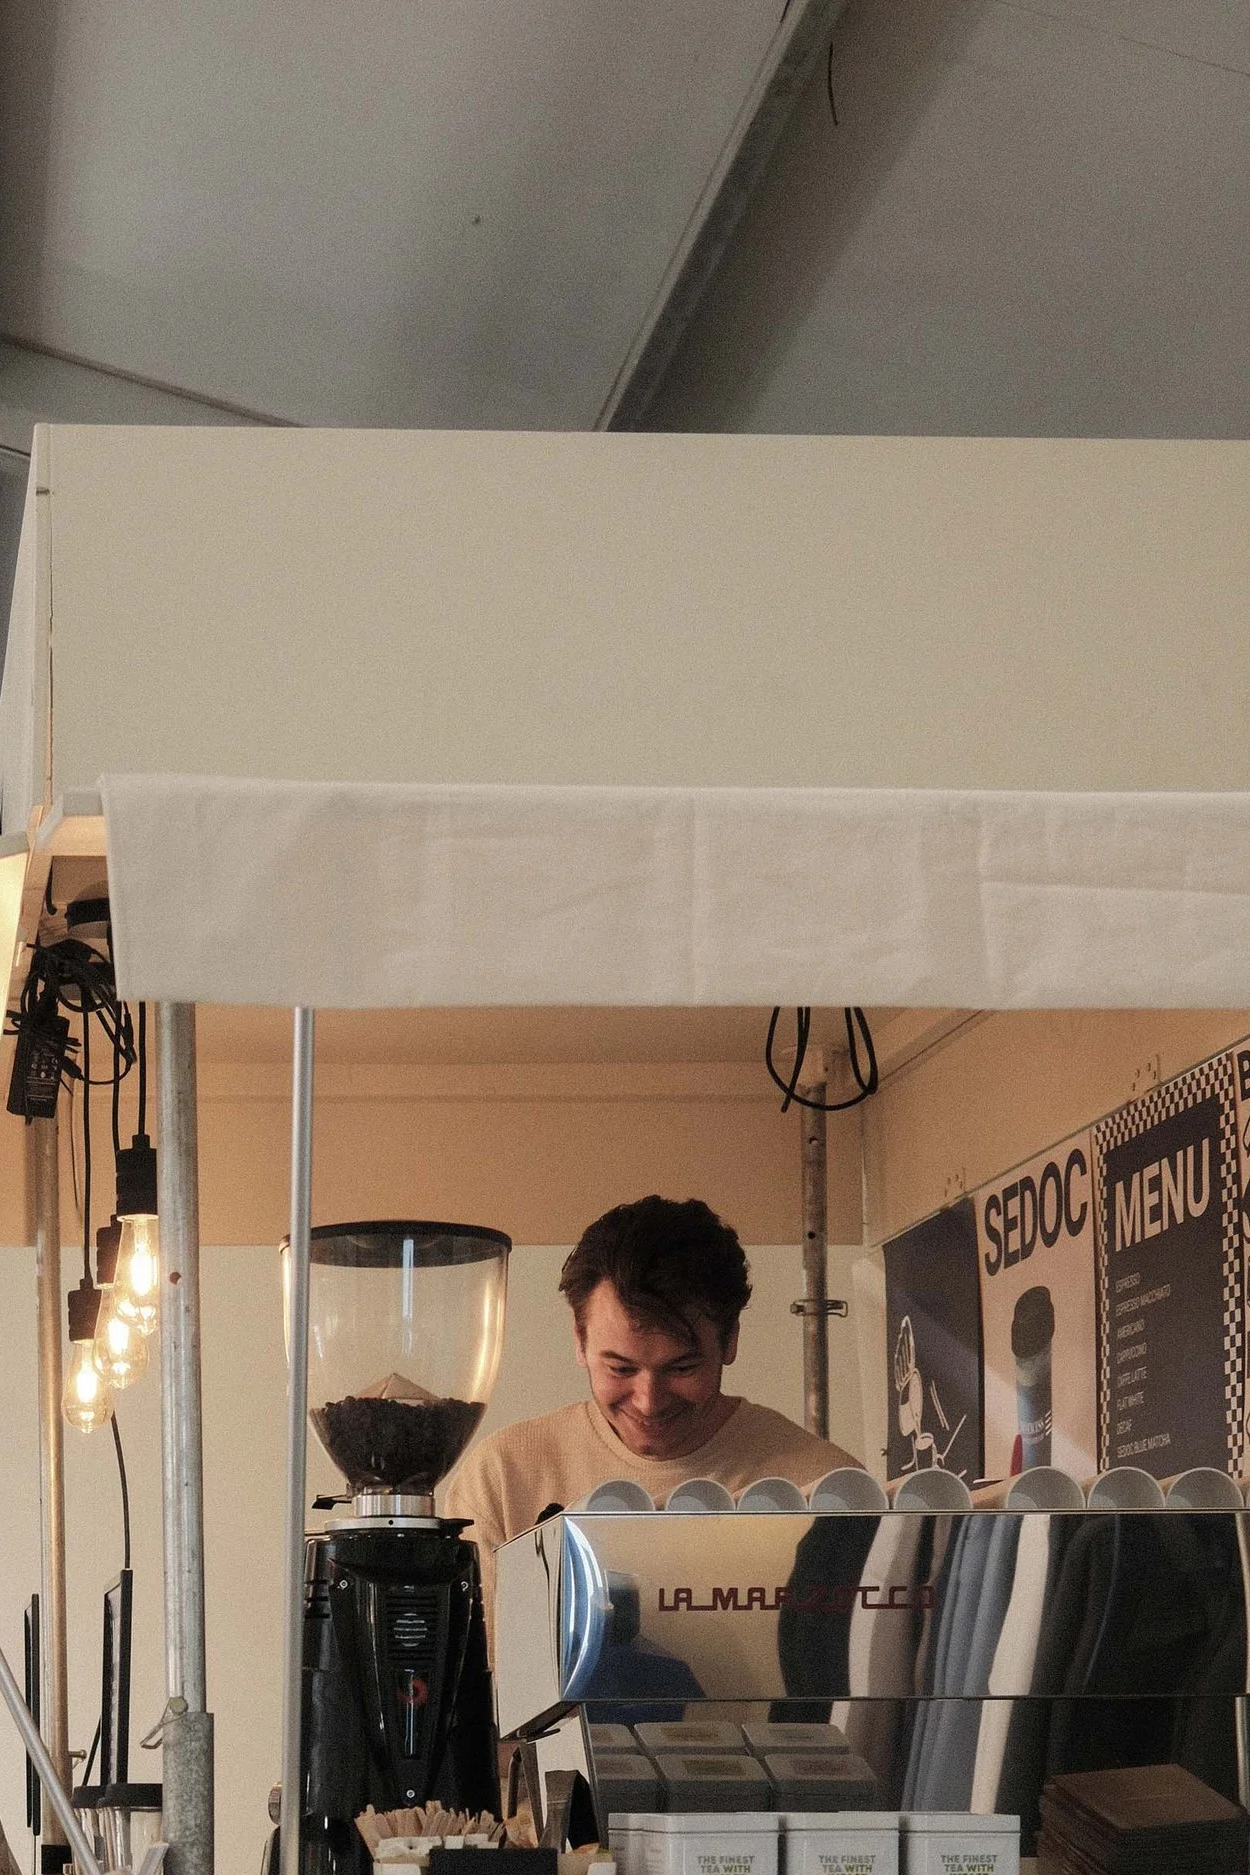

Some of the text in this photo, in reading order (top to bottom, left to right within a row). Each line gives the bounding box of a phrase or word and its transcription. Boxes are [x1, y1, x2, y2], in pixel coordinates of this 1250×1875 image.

[1114, 1138, 1211, 1252] MENU
[984, 1148, 1088, 1276] SEDOC
[659, 1588, 692, 1611] LA
[697, 1856, 755, 1865] THE FINEST
[818, 1855, 876, 1864] THE FINEST
[940, 1854, 998, 1863] THE FINEST
[701, 1865, 751, 1874] TEA WITH
[822, 1864, 872, 1873] TEA WITH
[944, 1863, 994, 1873] TEA WITH
